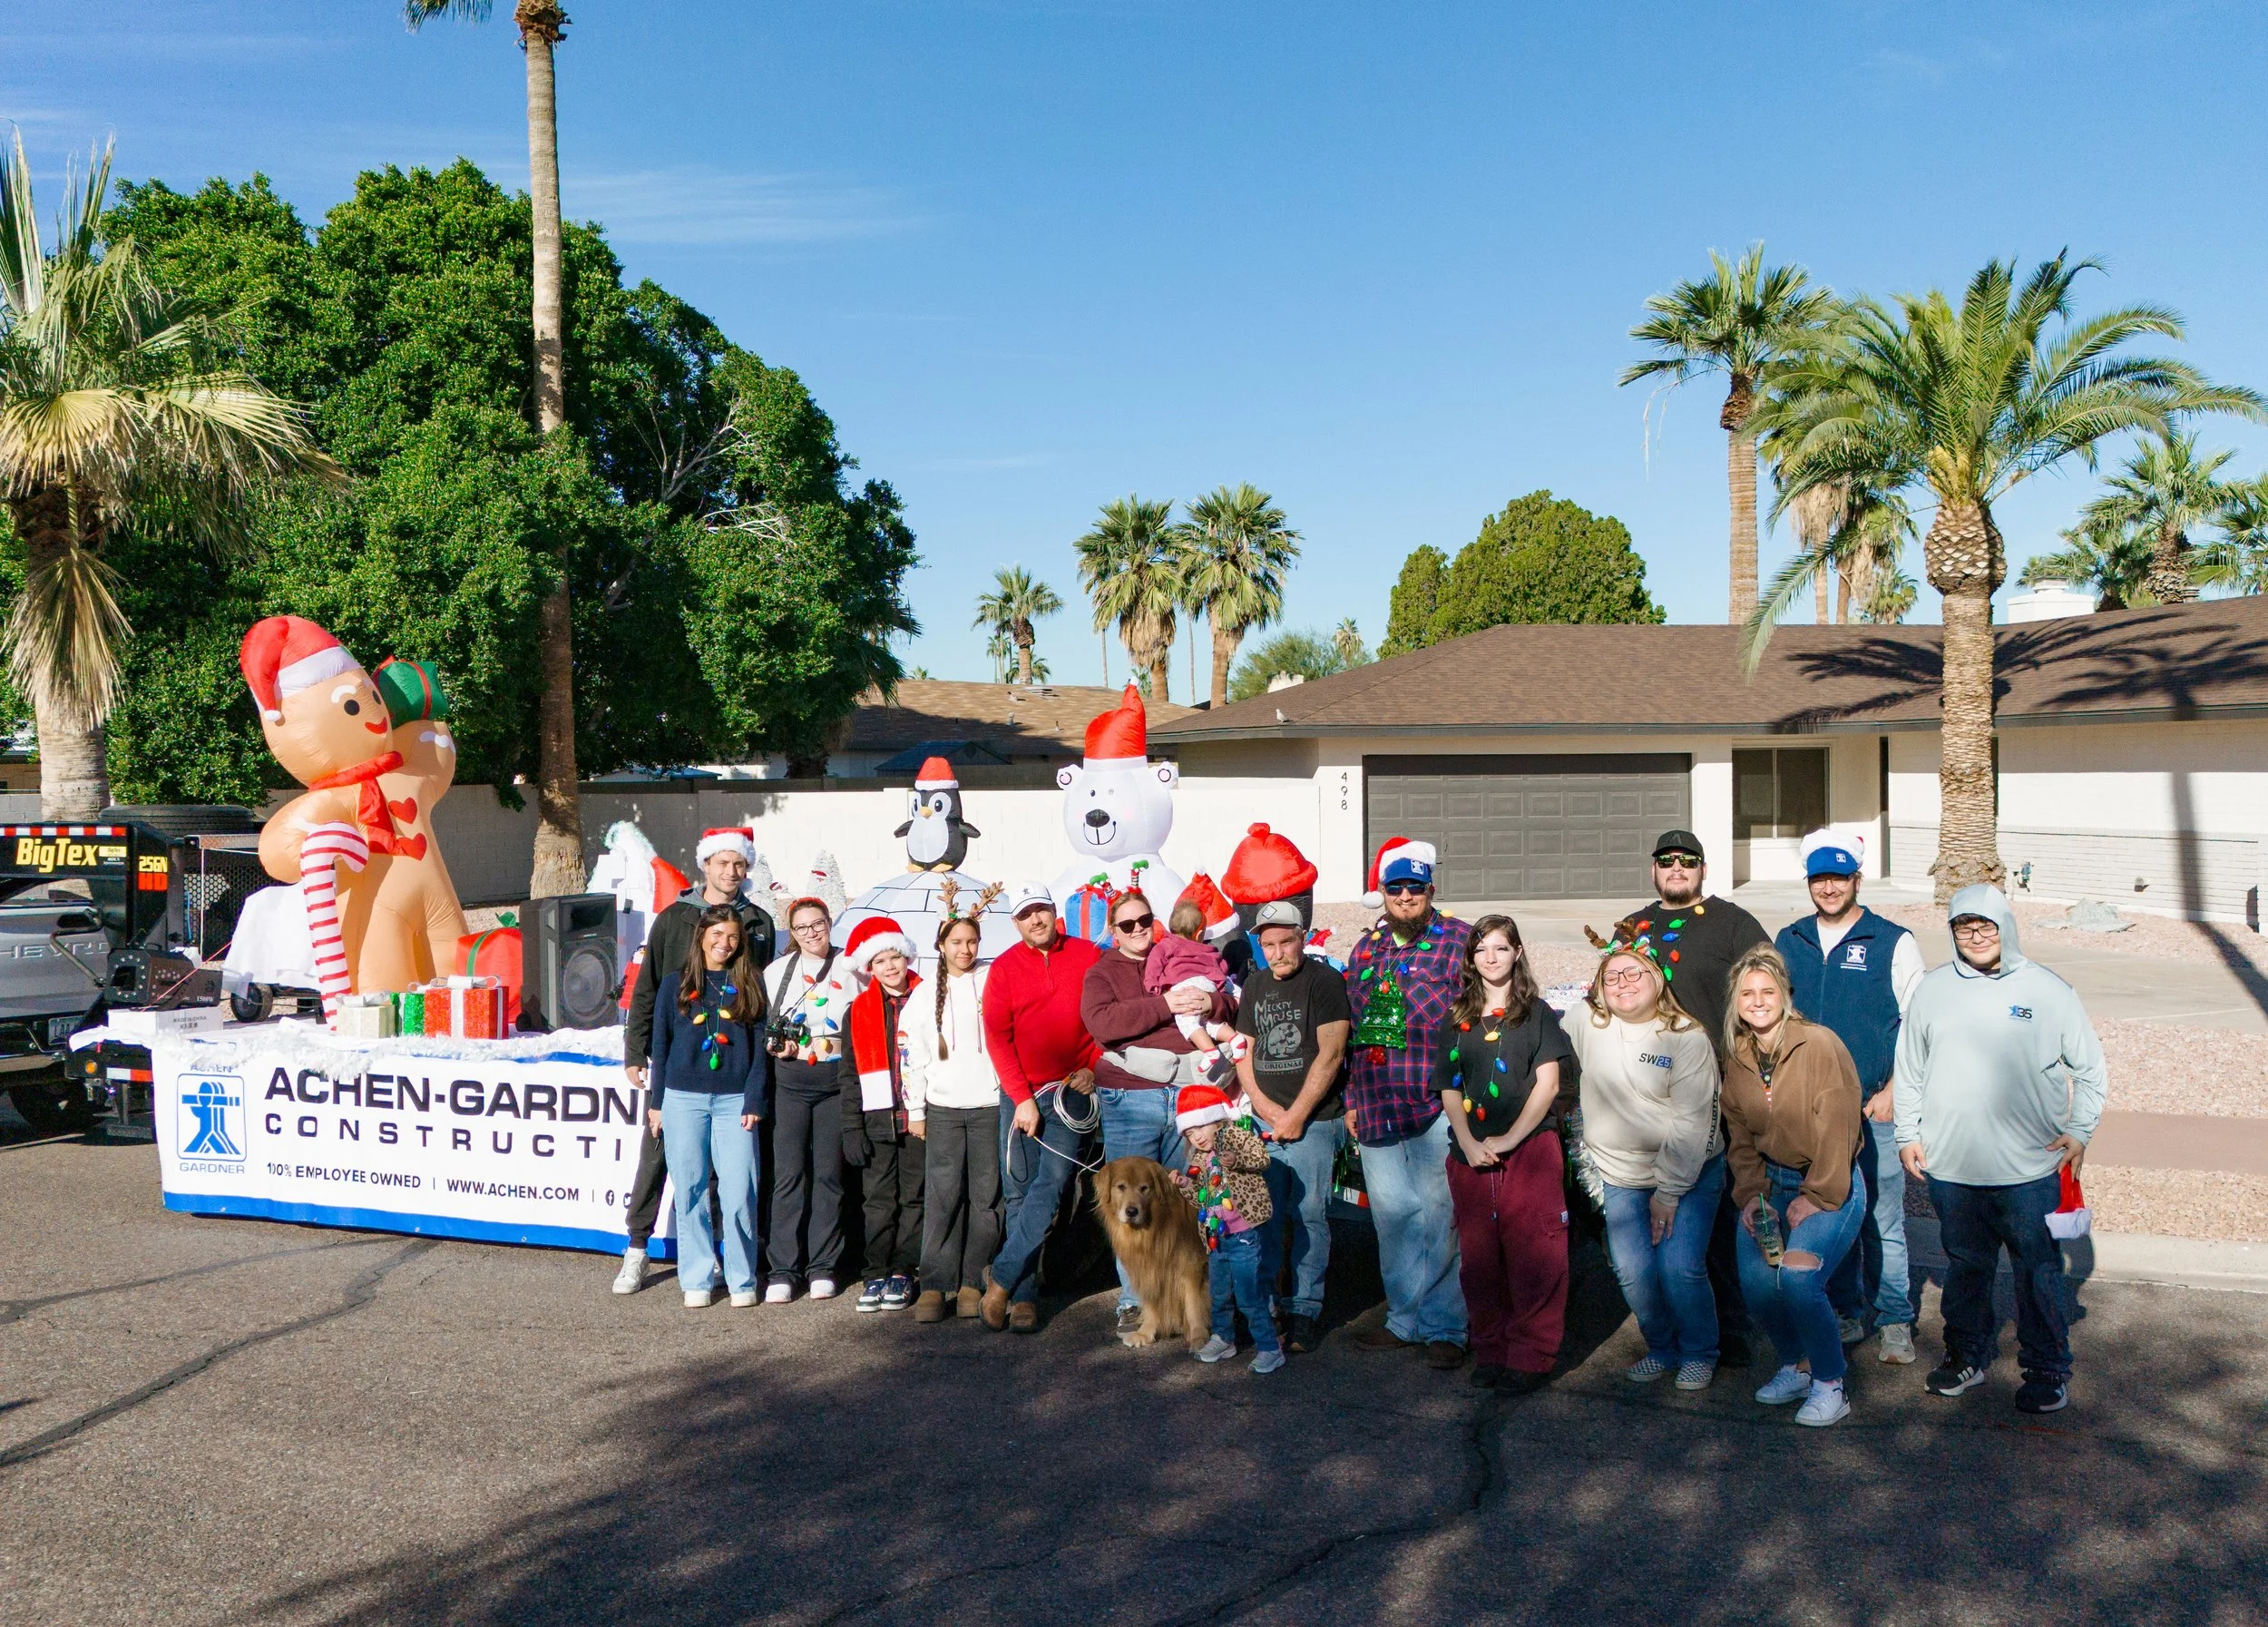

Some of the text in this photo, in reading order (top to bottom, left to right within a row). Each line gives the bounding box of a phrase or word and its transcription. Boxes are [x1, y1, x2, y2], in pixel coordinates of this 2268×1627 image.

[15, 838, 99, 873] BigTex
[138, 873, 168, 890] HD
[264, 1067, 650, 1126] ACHEN-GARDN
[180, 1162, 245, 1174] GARDNER
[296, 1165, 367, 1182] EMPLOYEE
[371, 1172, 421, 1188] OWNED
[446, 1179, 580, 1201] WWW.ACHEN.COM
